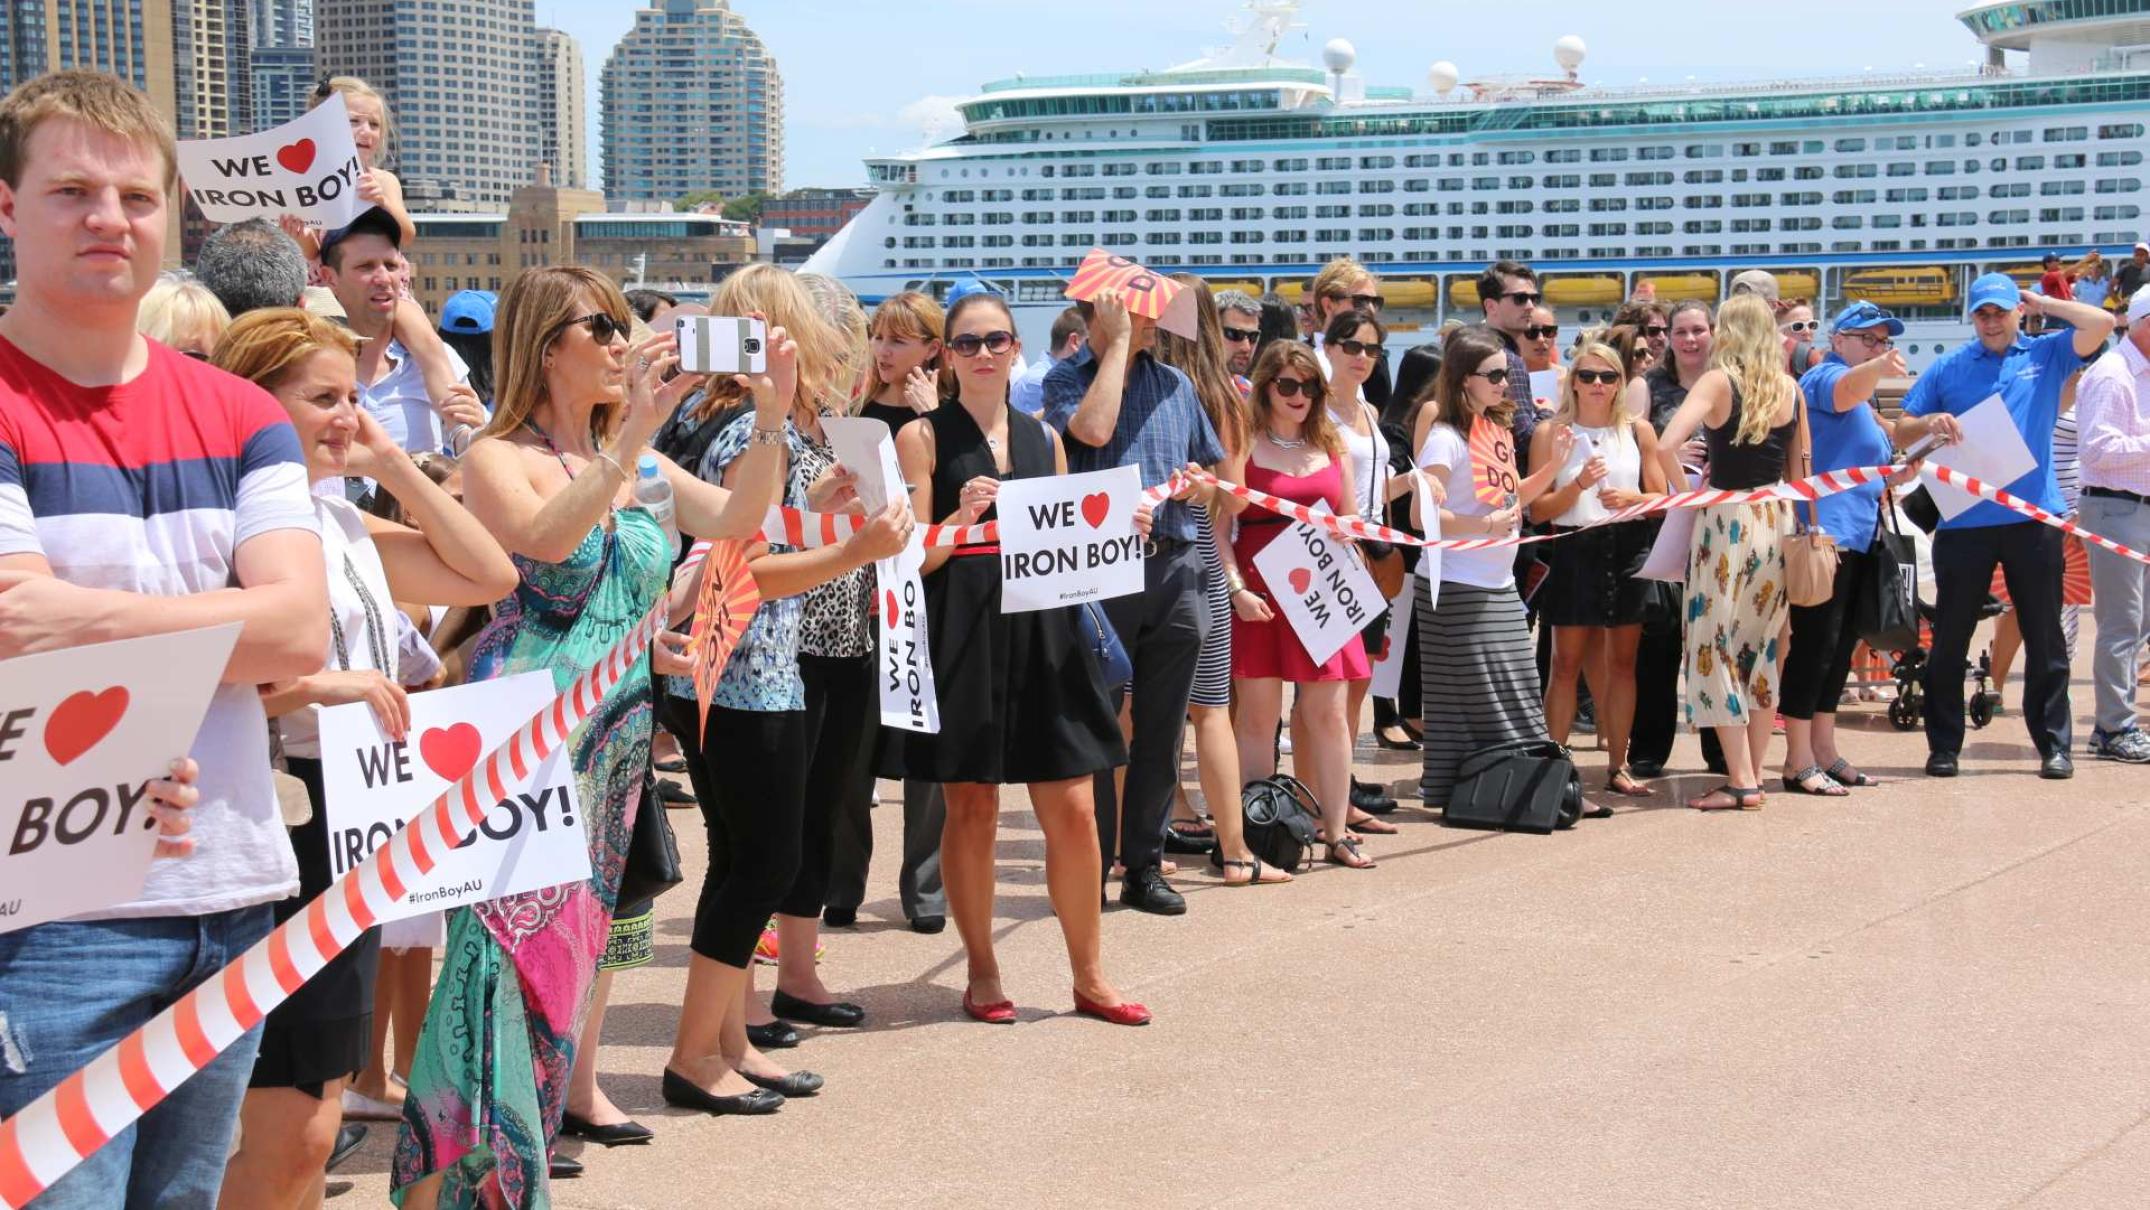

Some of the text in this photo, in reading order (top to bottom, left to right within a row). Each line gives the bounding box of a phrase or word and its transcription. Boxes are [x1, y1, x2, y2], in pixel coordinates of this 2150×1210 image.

[194, 155, 361, 208] IRON BOY!
[211, 155, 273, 178] WE
[1028, 500, 1075, 531] WE
[1005, 534, 1141, 580] IRON BOY!
[1304, 590, 1331, 629] WE
[1326, 569, 1366, 625] IRON
[889, 637, 901, 693] WE
[904, 580, 924, 728] IRON BO
[356, 740, 414, 789] WE
[333, 785, 575, 875] IRO OY!
[409, 879, 483, 905] #IronBoyAU
